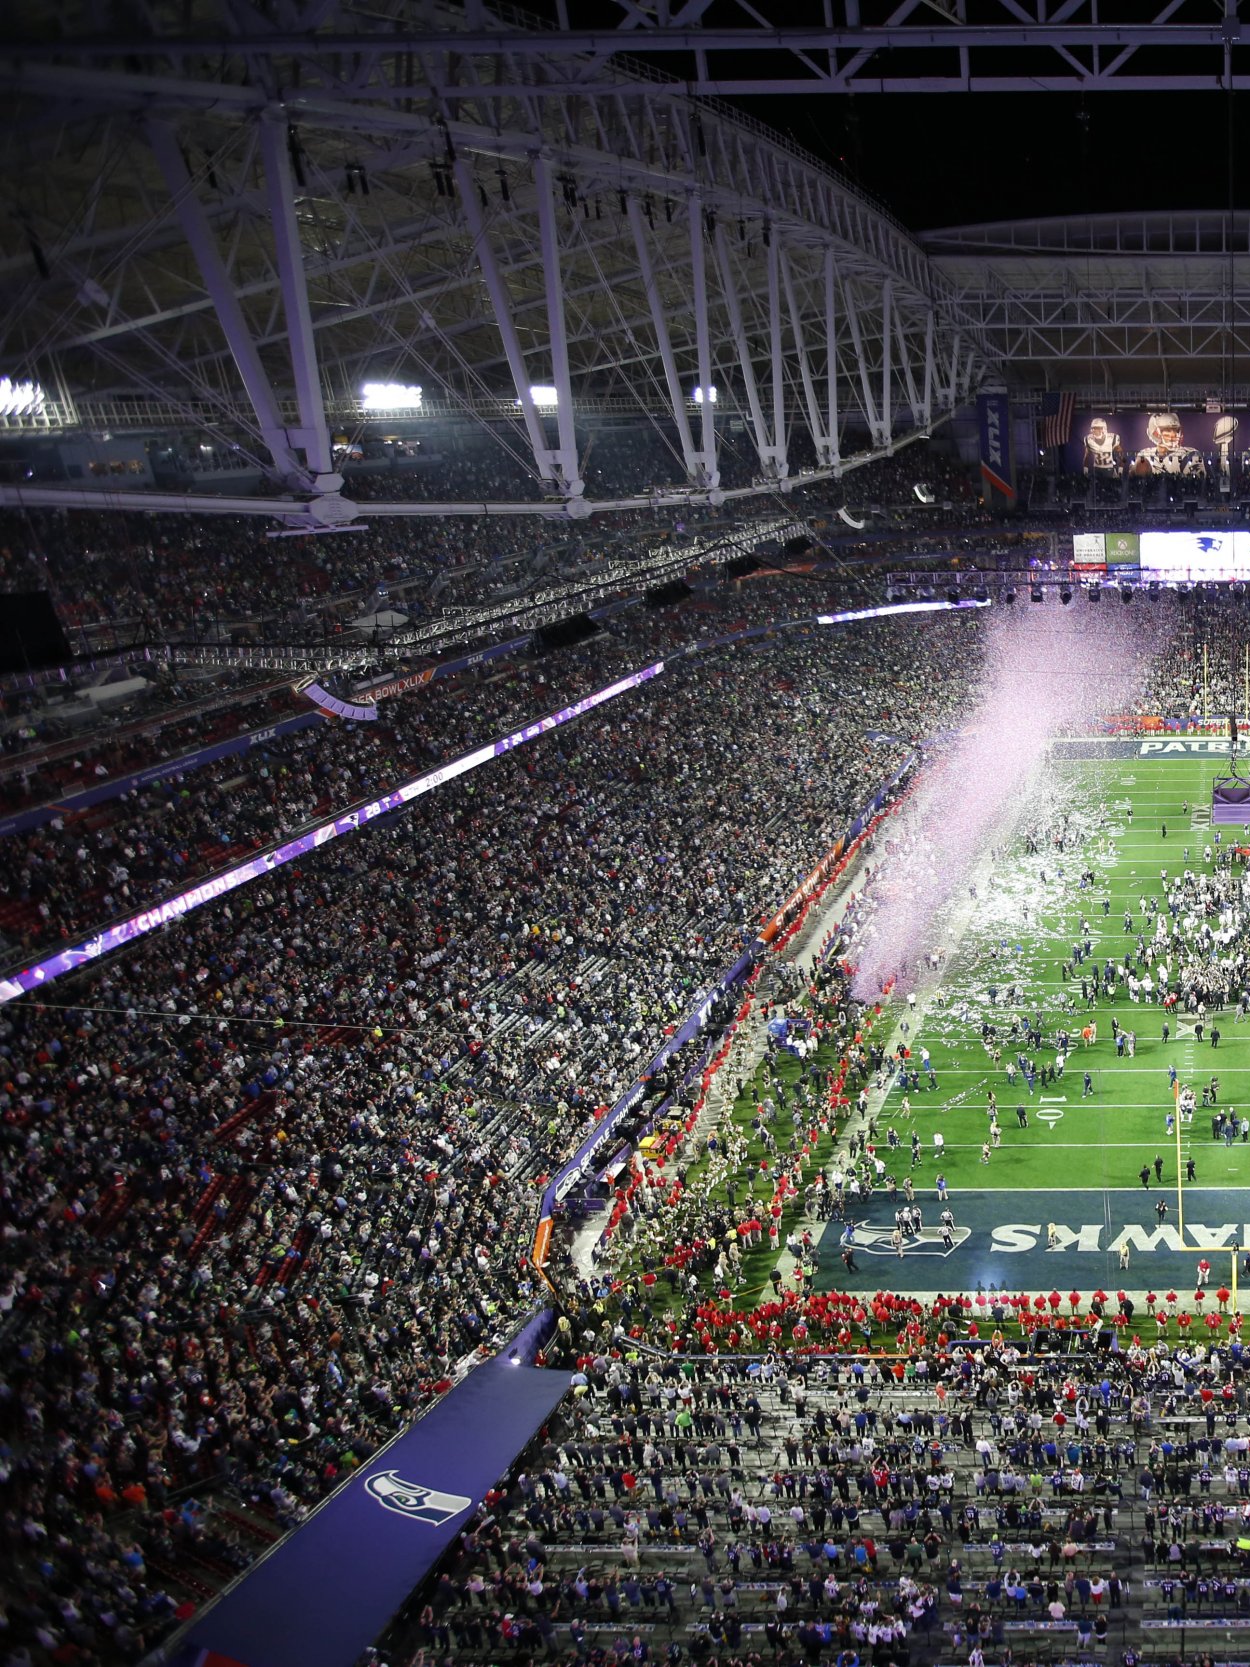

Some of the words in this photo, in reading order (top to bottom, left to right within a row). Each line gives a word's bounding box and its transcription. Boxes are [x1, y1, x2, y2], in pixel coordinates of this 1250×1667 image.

[987, 407, 1002, 467] XLIX
[375, 682, 403, 699] BOWL
[403, 673, 425, 690] XLIX
[249, 728, 276, 745] XLIX
[425, 771, 444, 788] 2:00
[365, 801, 381, 819] 28
[138, 872, 238, 932] CHAMPIONS
[1035, 1095, 1067, 1121] 10
